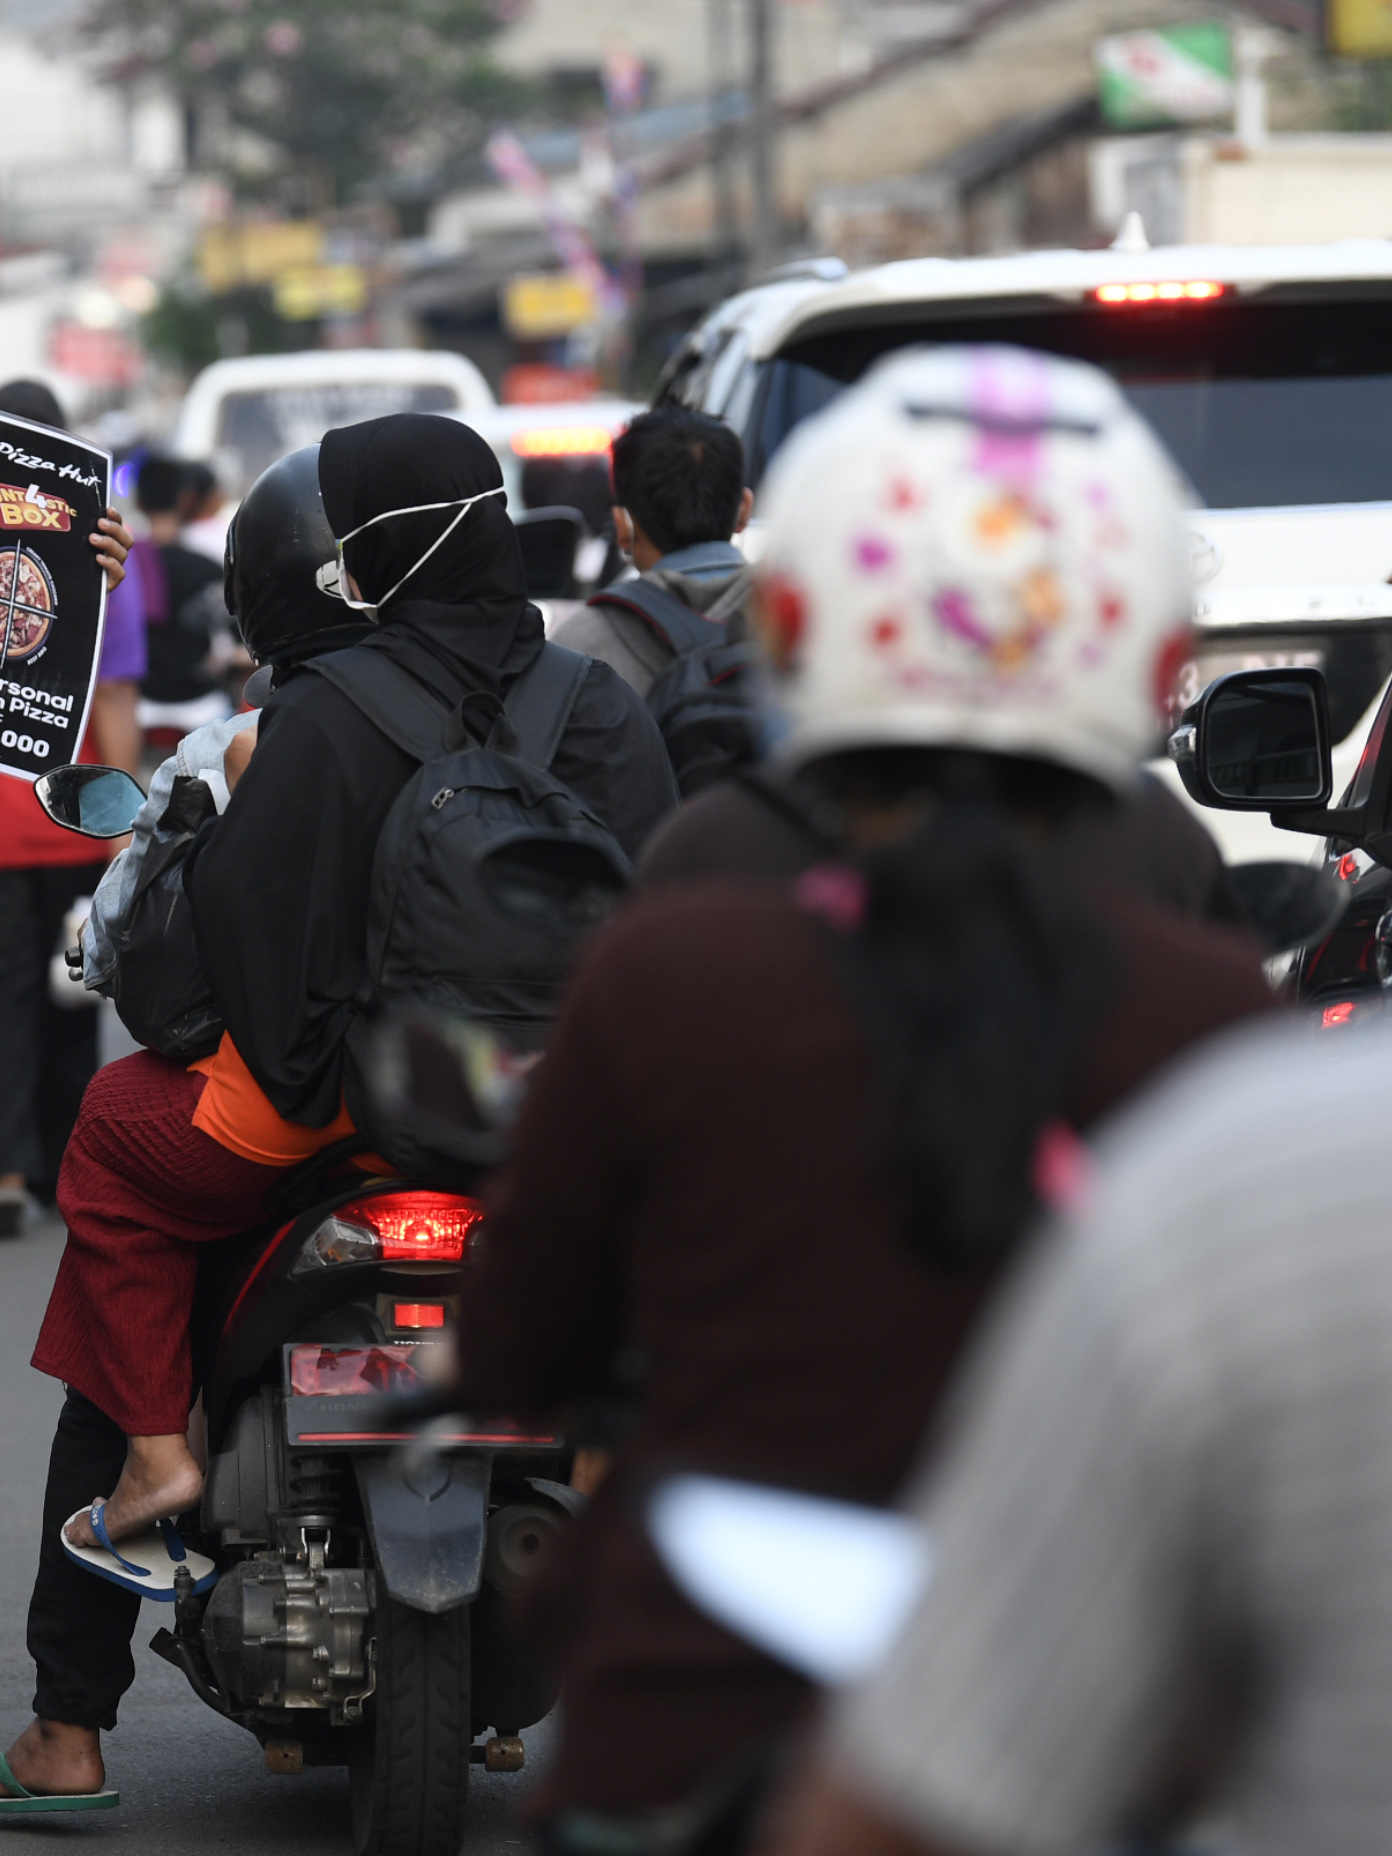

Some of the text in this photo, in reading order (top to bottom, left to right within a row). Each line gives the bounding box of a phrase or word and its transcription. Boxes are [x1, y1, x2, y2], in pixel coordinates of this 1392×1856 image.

[58, 464, 103, 487] Hut
[0, 502, 63, 529] BOX
[9, 696, 70, 729] Pizza
